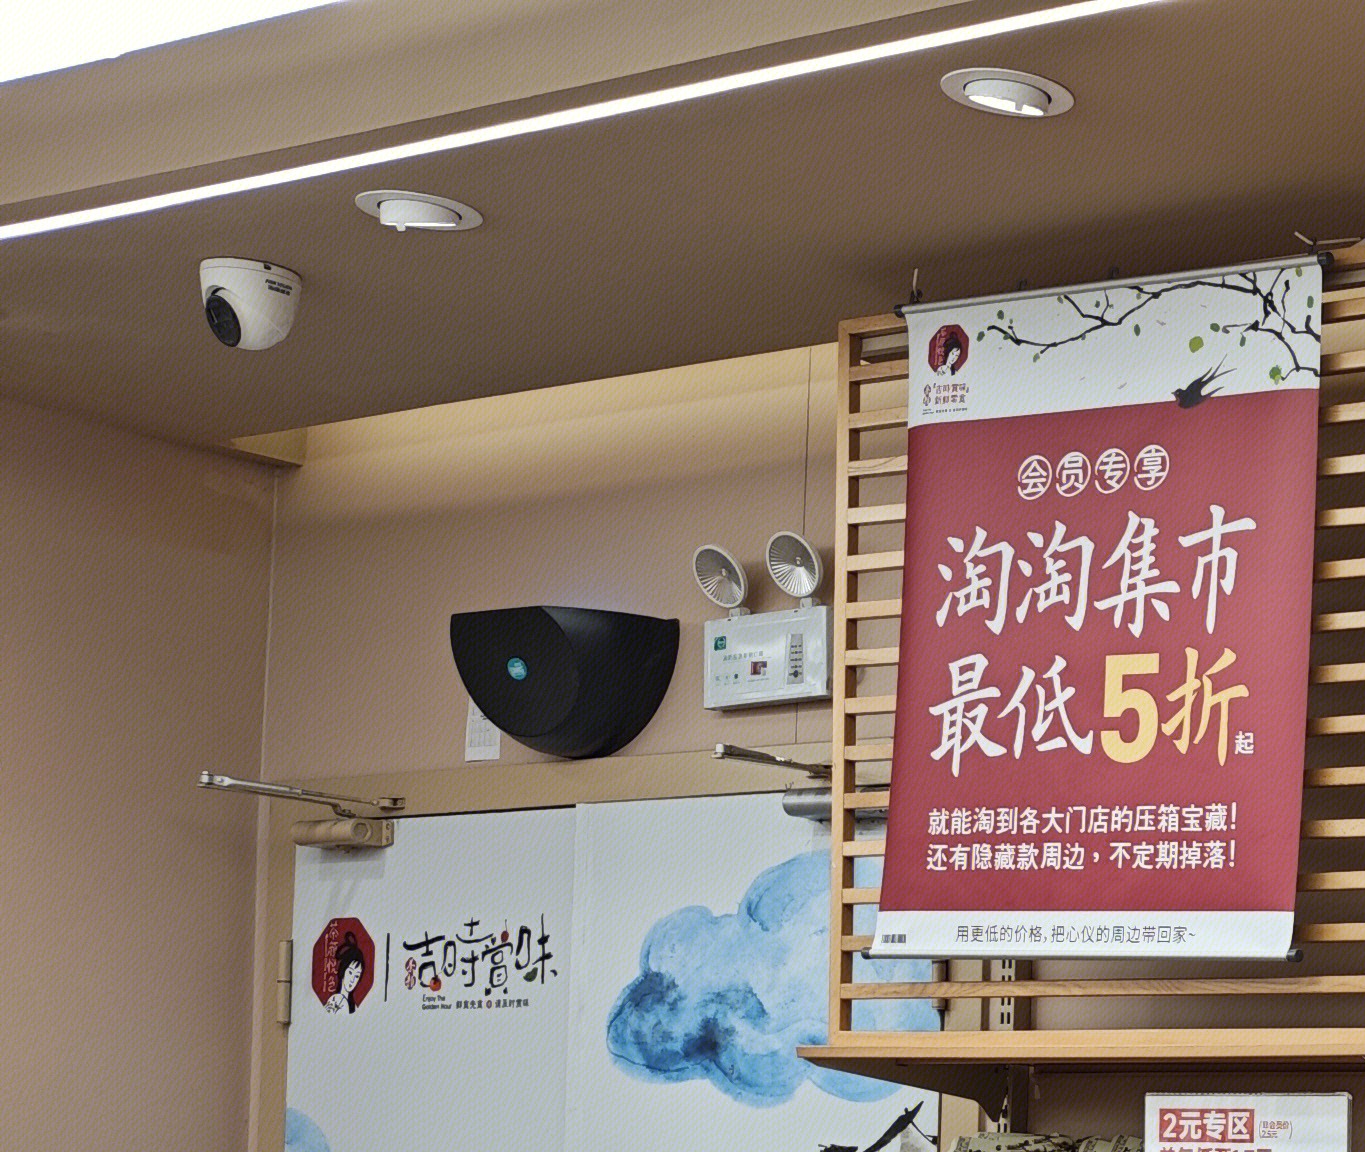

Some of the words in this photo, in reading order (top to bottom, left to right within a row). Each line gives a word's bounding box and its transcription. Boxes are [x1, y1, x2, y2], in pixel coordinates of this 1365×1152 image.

[1017, 444, 1170, 500] 会员专享
[934, 504, 1258, 638] 淘淘集市
[928, 647, 1256, 778] 最低5折起
[1162, 1111, 1250, 1141] 2元专区
